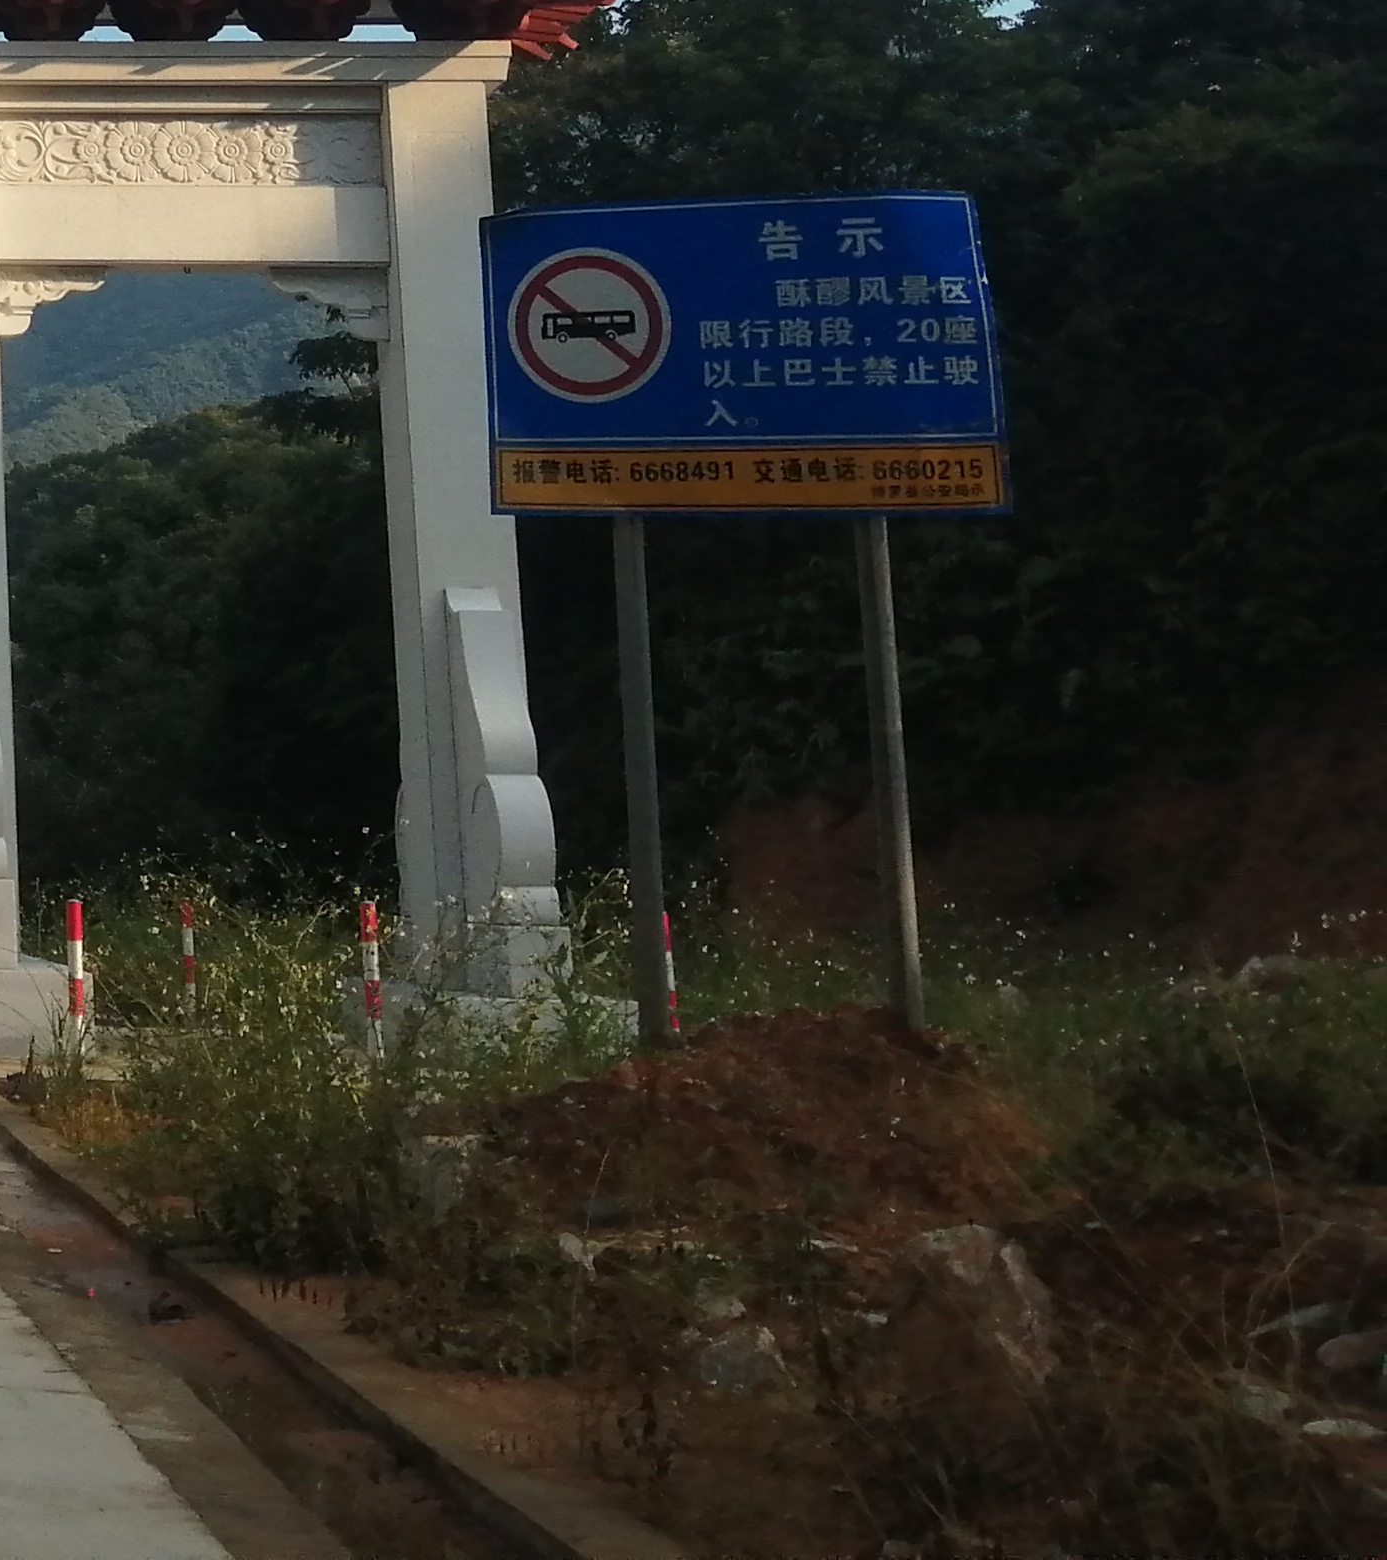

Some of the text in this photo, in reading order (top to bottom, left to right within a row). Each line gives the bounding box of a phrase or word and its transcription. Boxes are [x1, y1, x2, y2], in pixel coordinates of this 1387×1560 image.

[760, 217, 884, 261] 告示
[704, 355, 979, 388] 以上巴士禁止驶
[630, 460, 735, 483] 6668491
[872, 458, 984, 481] 6660215
